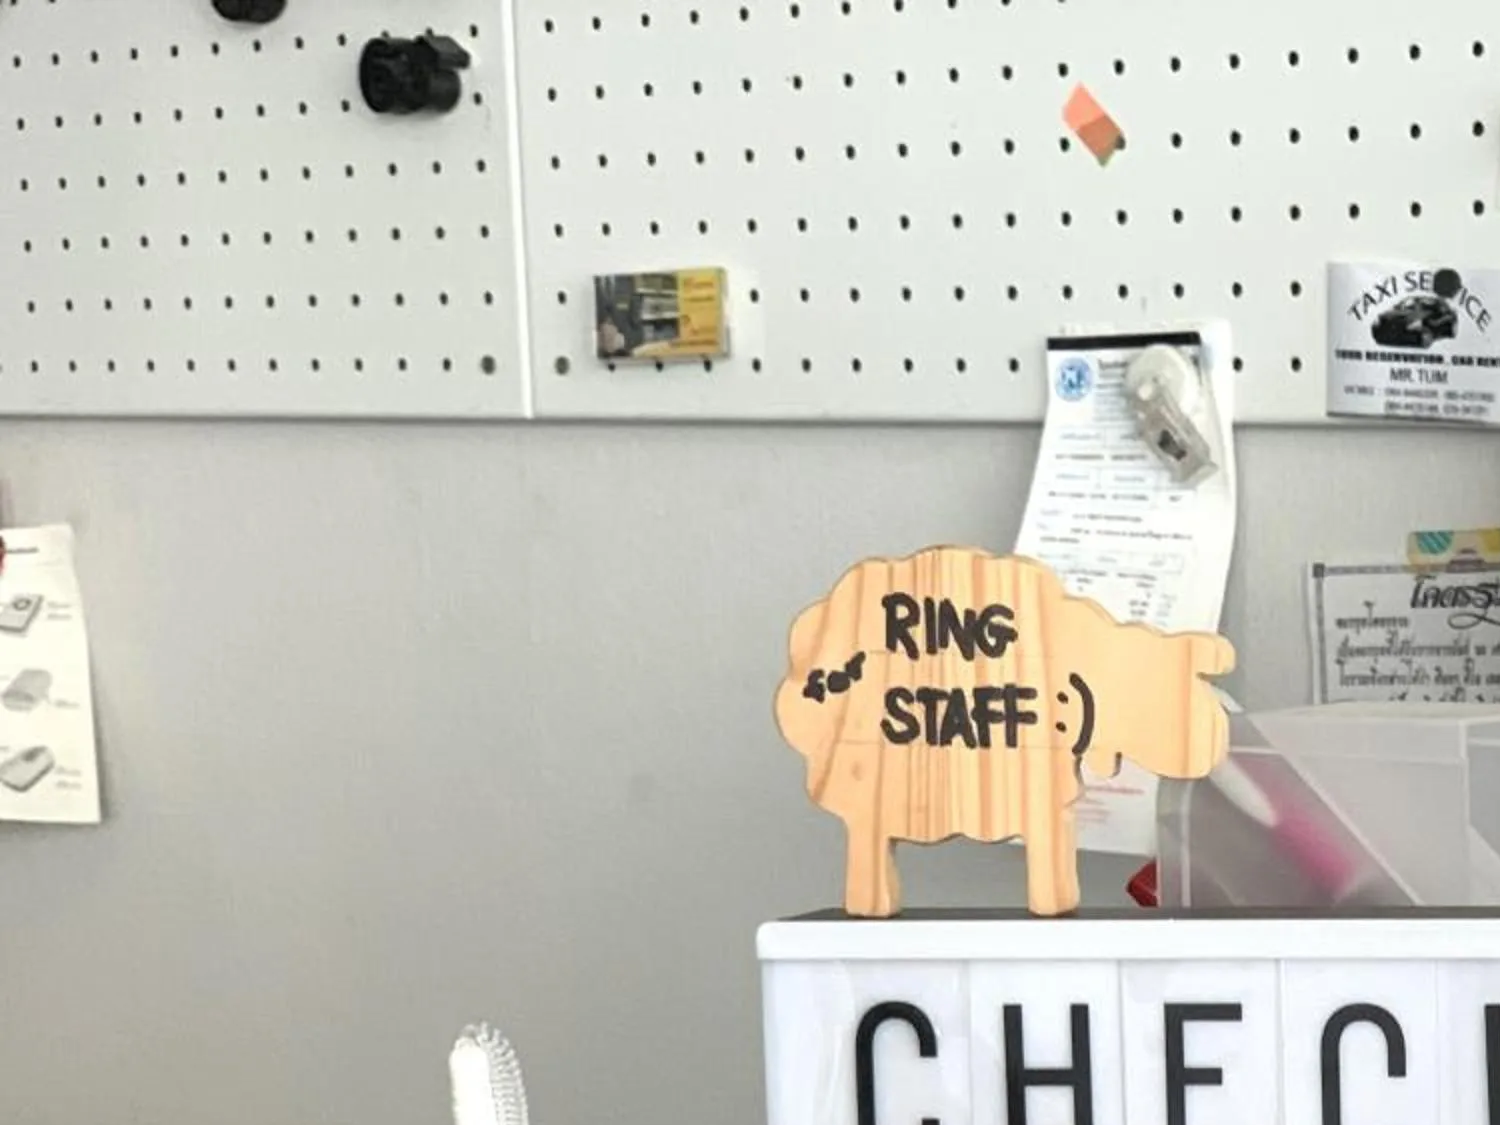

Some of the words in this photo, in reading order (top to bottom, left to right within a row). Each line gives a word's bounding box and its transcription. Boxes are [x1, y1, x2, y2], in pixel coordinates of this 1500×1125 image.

[1347, 274, 1400, 323] TAXI
[1404, 269, 1493, 334] SEICE
[882, 591, 1019, 661] RING
[880, 685, 1038, 750] STAFF
